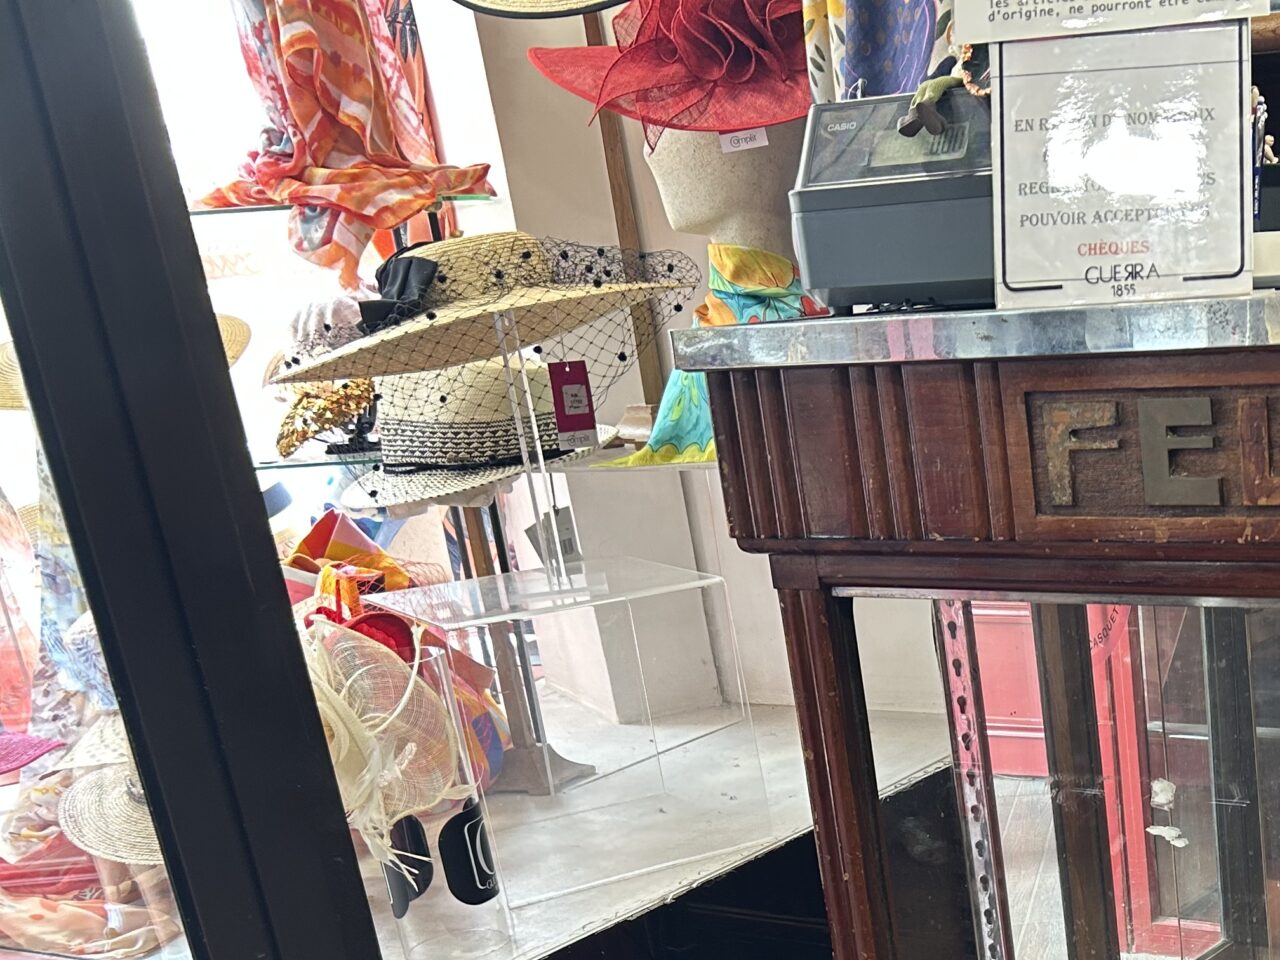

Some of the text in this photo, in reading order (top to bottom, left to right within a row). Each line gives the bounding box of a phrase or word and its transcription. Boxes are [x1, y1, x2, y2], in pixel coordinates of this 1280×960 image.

[989, 6, 1060, 22] d'origine,
[1069, 5, 1084, 14] ne
[1092, 0, 1152, 14] pourront
[828, 121, 857, 132] CASIO
[1014, 118, 1035, 133] EN
[1019, 210, 1087, 227] POUVOIR
[1111, 283, 1137, 298] 1855
[1090, 606, 1119, 650] ASQUET
